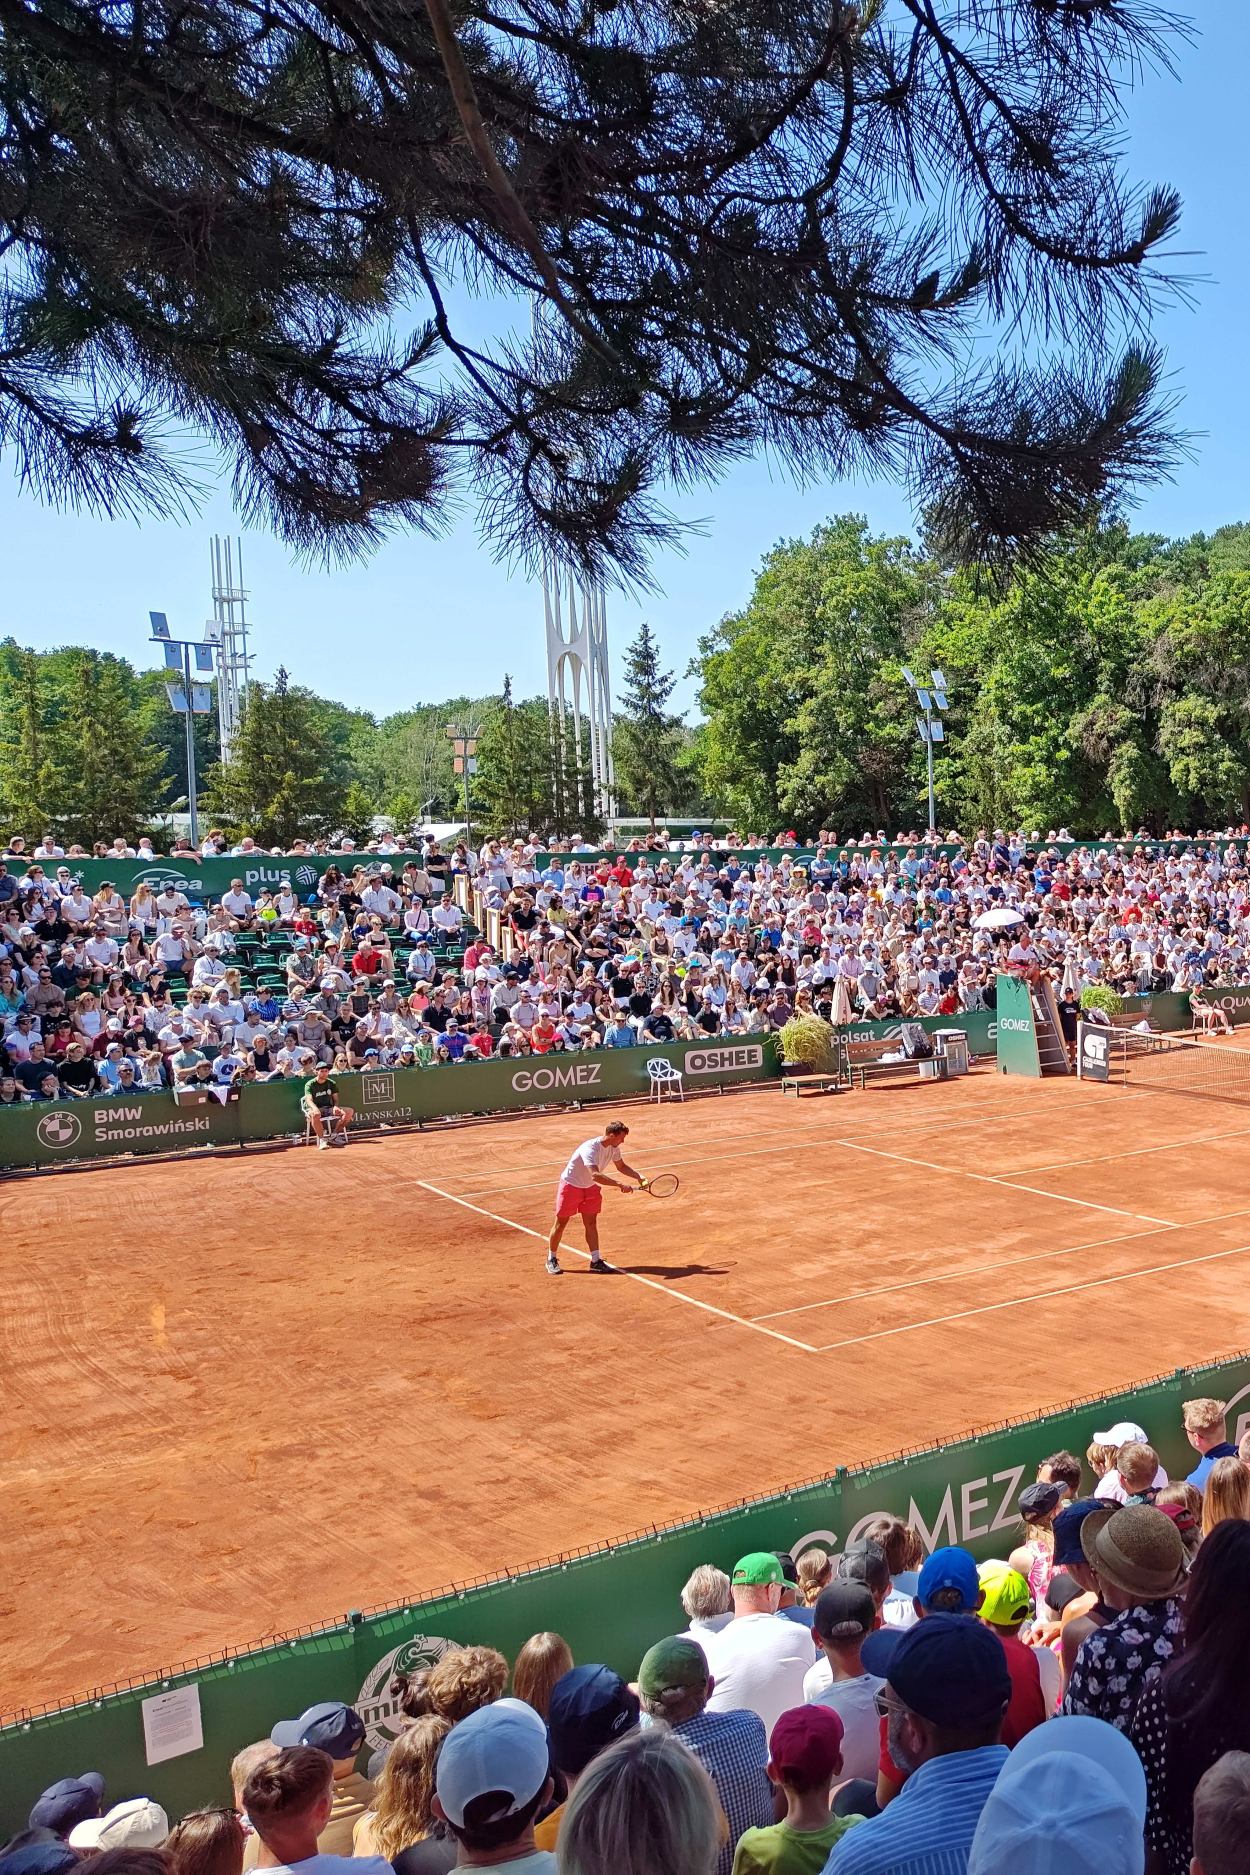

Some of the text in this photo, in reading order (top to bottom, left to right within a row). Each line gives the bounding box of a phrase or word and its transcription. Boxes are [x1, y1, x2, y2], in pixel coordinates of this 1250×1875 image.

[245, 866, 291, 886] plus
[1000, 1017, 1030, 1032] GOMEZ
[830, 1029, 876, 1049] polsat
[689, 1048, 759, 1071] OSHEE
[511, 1063, 602, 1092] GOMEZ
[94, 1106, 142, 1124] BMW
[95, 1117, 210, 1142] Smorawiński
